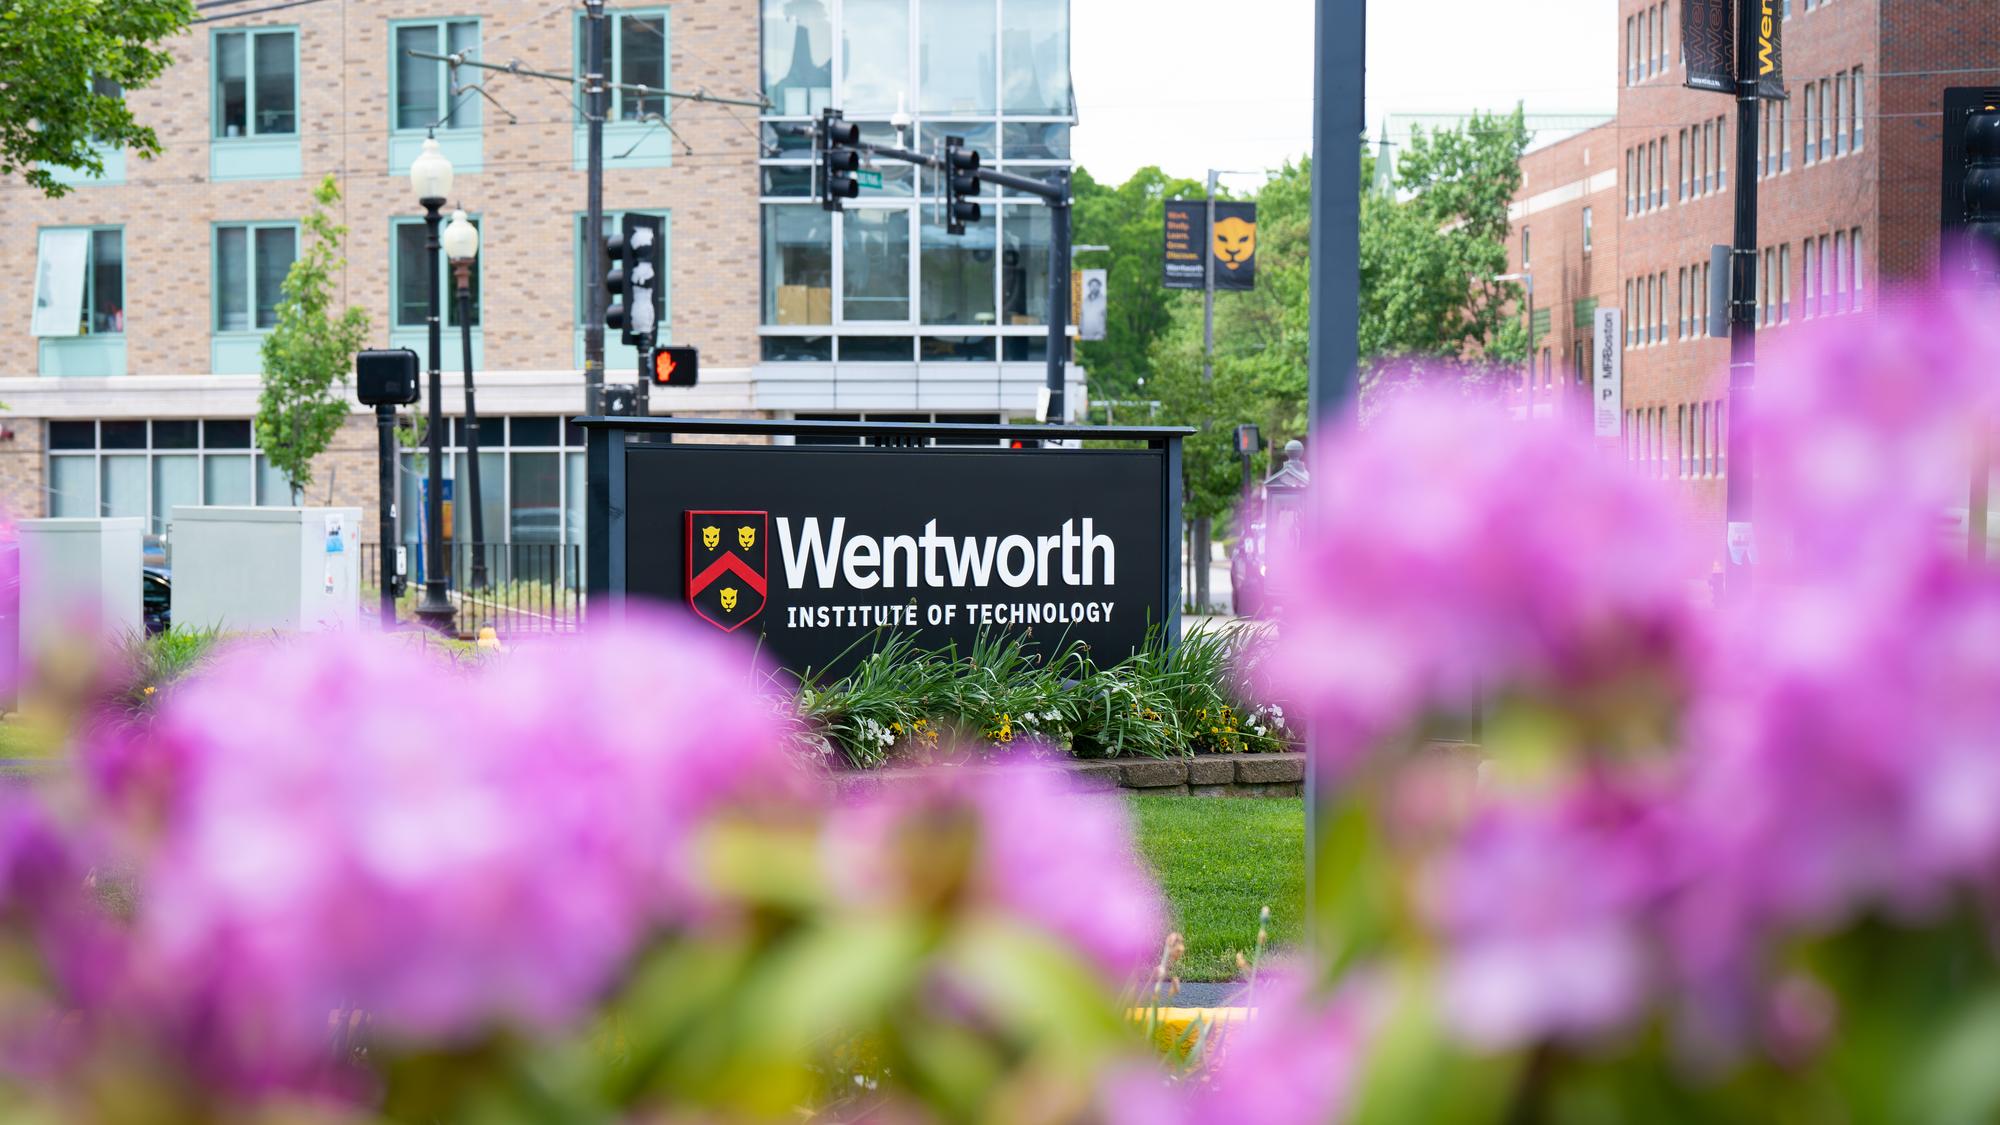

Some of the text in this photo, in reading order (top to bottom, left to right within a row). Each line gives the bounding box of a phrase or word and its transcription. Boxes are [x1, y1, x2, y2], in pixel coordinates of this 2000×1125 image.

[1602, 388, 1613, 401] P
[775, 516, 1115, 590] Wentworth
[787, 602, 1115, 628] INSTITUTE OF TECHNOLOGY
